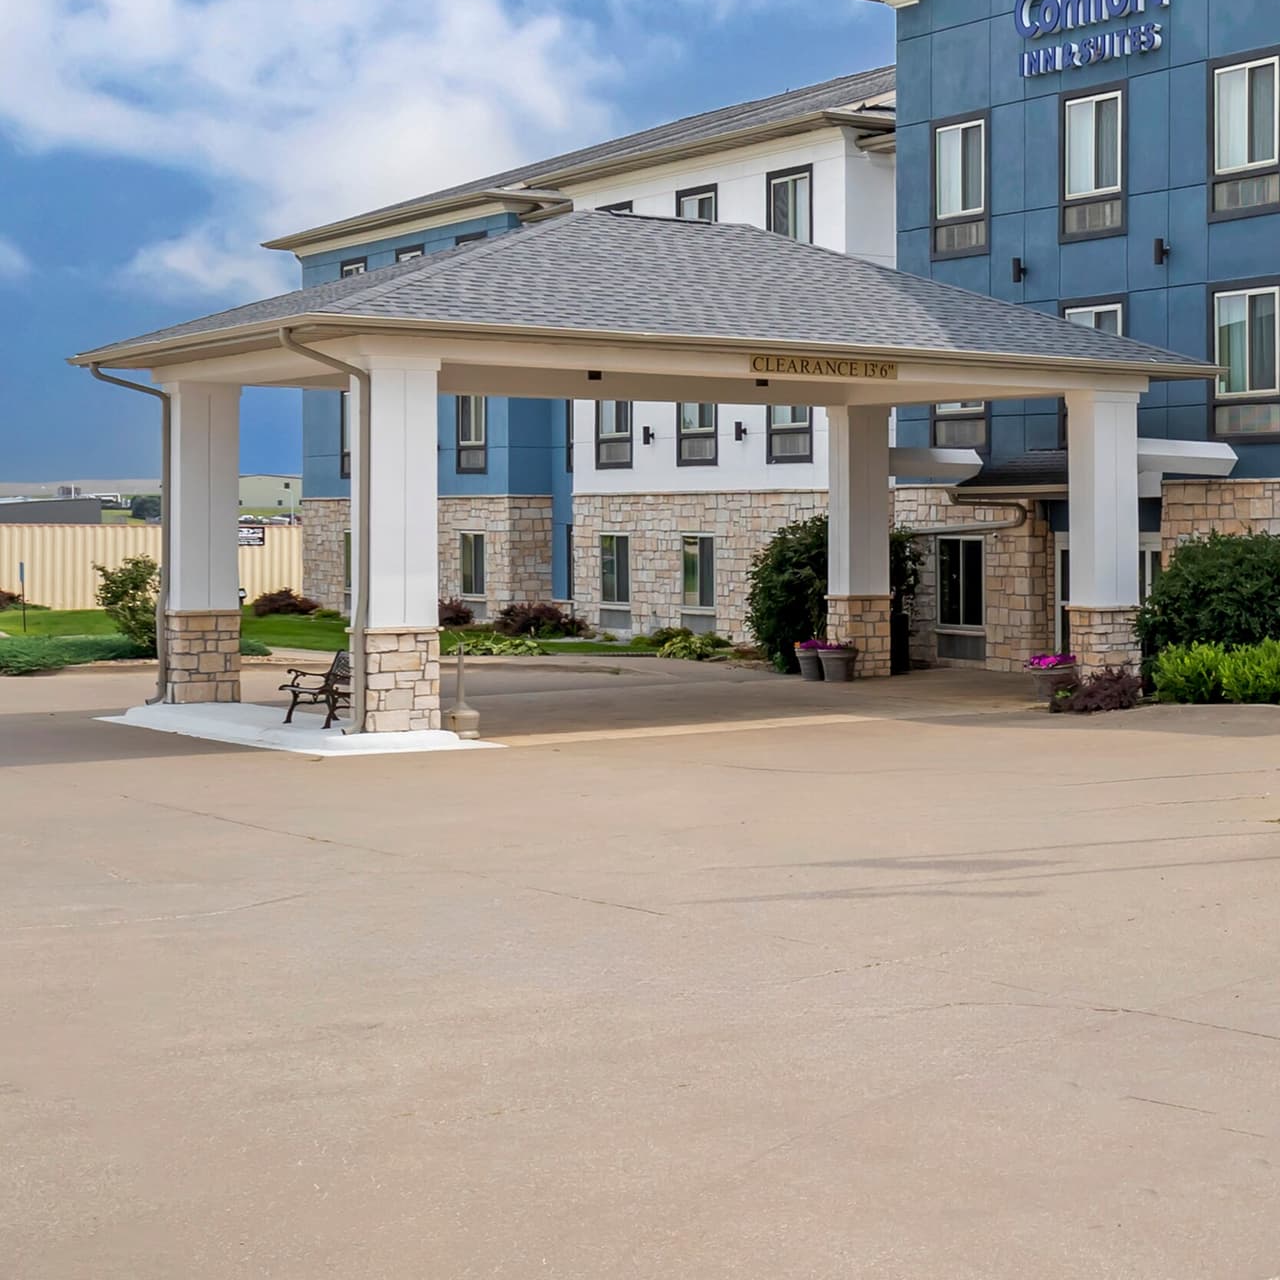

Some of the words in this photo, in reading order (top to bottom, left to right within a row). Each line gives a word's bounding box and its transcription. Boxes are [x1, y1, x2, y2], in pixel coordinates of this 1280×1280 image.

[1019, 45, 1063, 78] INN
[1081, 22, 1162, 64] SUITES
[752, 356, 859, 377] CLEARANCE
